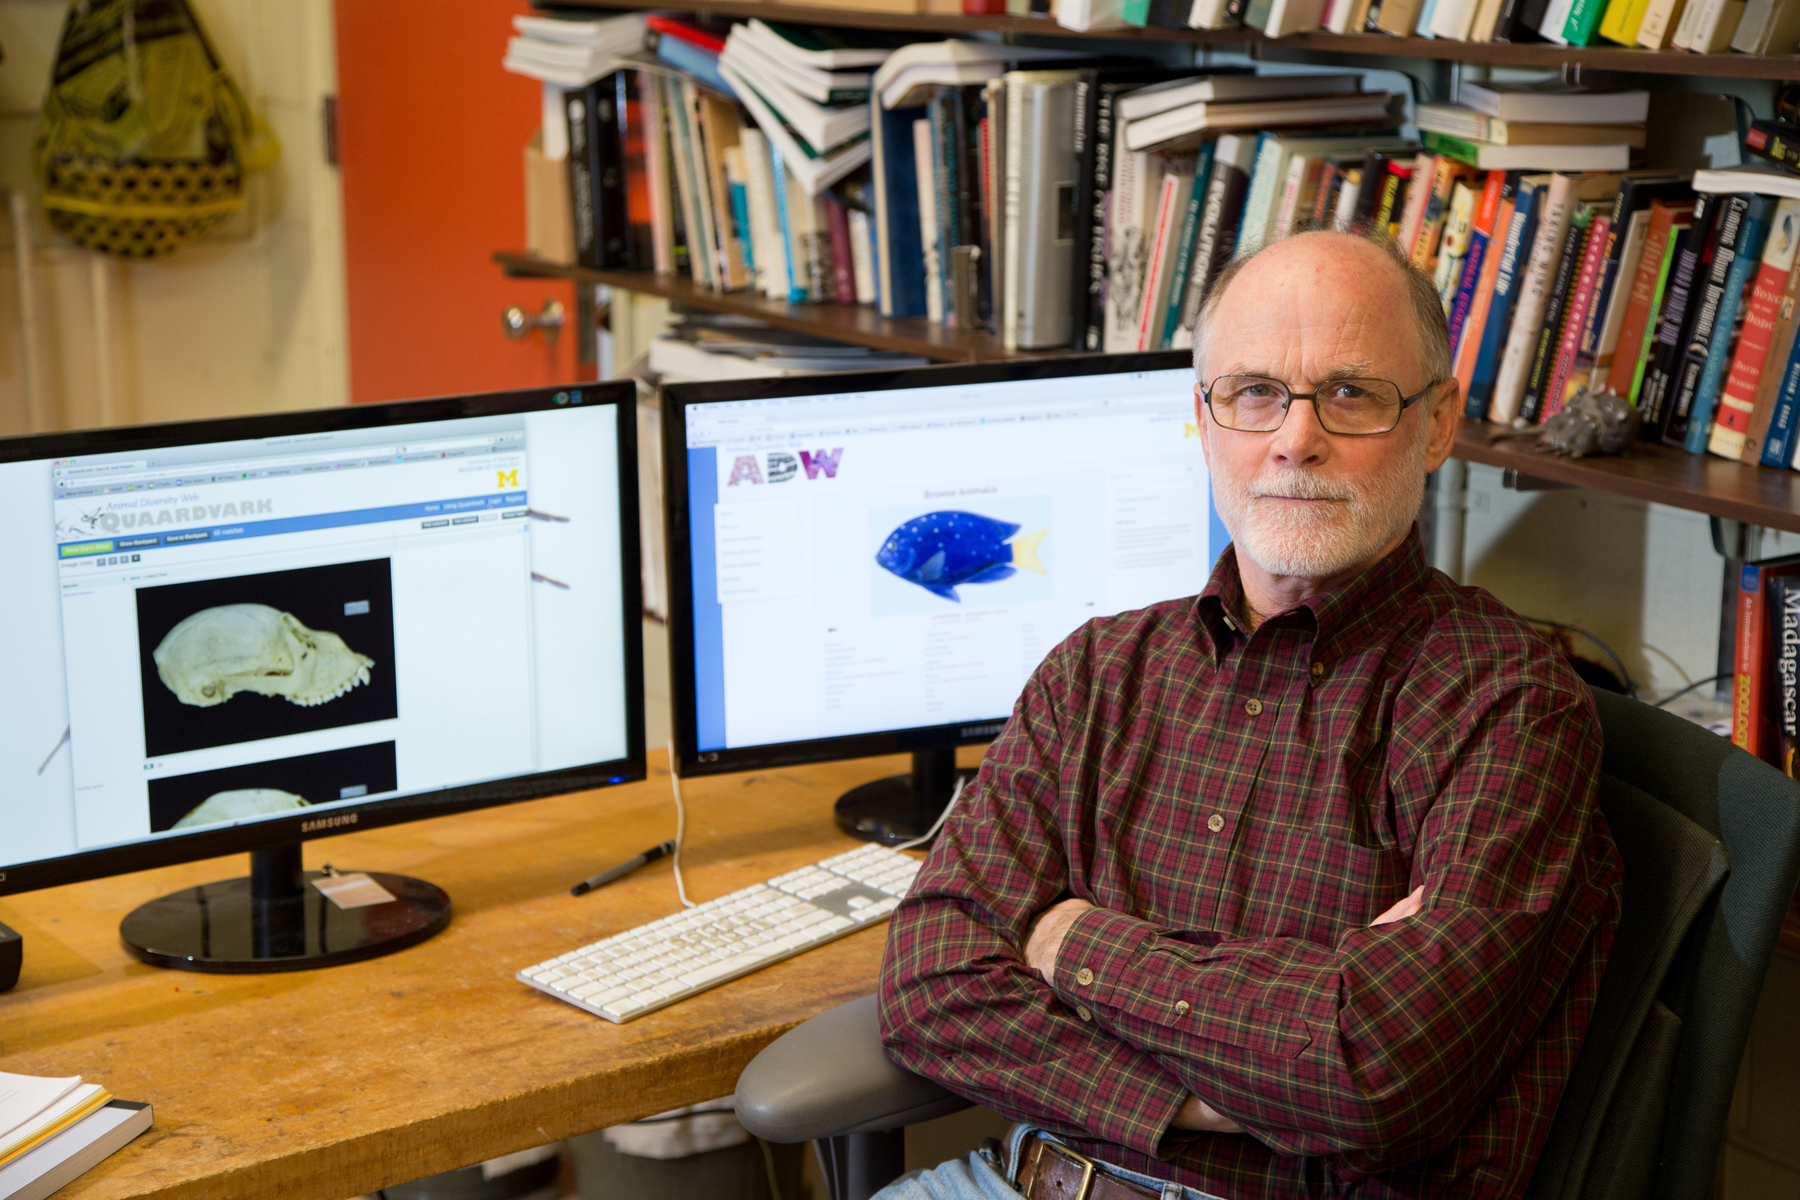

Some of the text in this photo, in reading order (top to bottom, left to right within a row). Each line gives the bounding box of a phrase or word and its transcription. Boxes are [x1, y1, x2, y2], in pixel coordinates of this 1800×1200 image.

[1191, 179, 1226, 286] EVOLUTION
[1543, 203, 1564, 252] TAKING
[1461, 240, 1482, 289] ANIMAL
[1494, 211, 1527, 296] Wonderful Life
[1531, 260, 1550, 297] WING
[1753, 285, 1783, 305] SONG
[1746, 310, 1776, 331] DODO
[1736, 360, 1760, 375] DAVID
[1184, 423, 1201, 437] M
[497, 469, 519, 488] M
[727, 447, 844, 487] ADW
[100, 498, 273, 534] QUAARDVARK
[106, 492, 199, 511] Animal Diversity Web
[1777, 588, 1800, 736] Madagascar
[1736, 673, 1751, 749] ZOOLOGY
[301, 812, 359, 833] SAMSUNG
